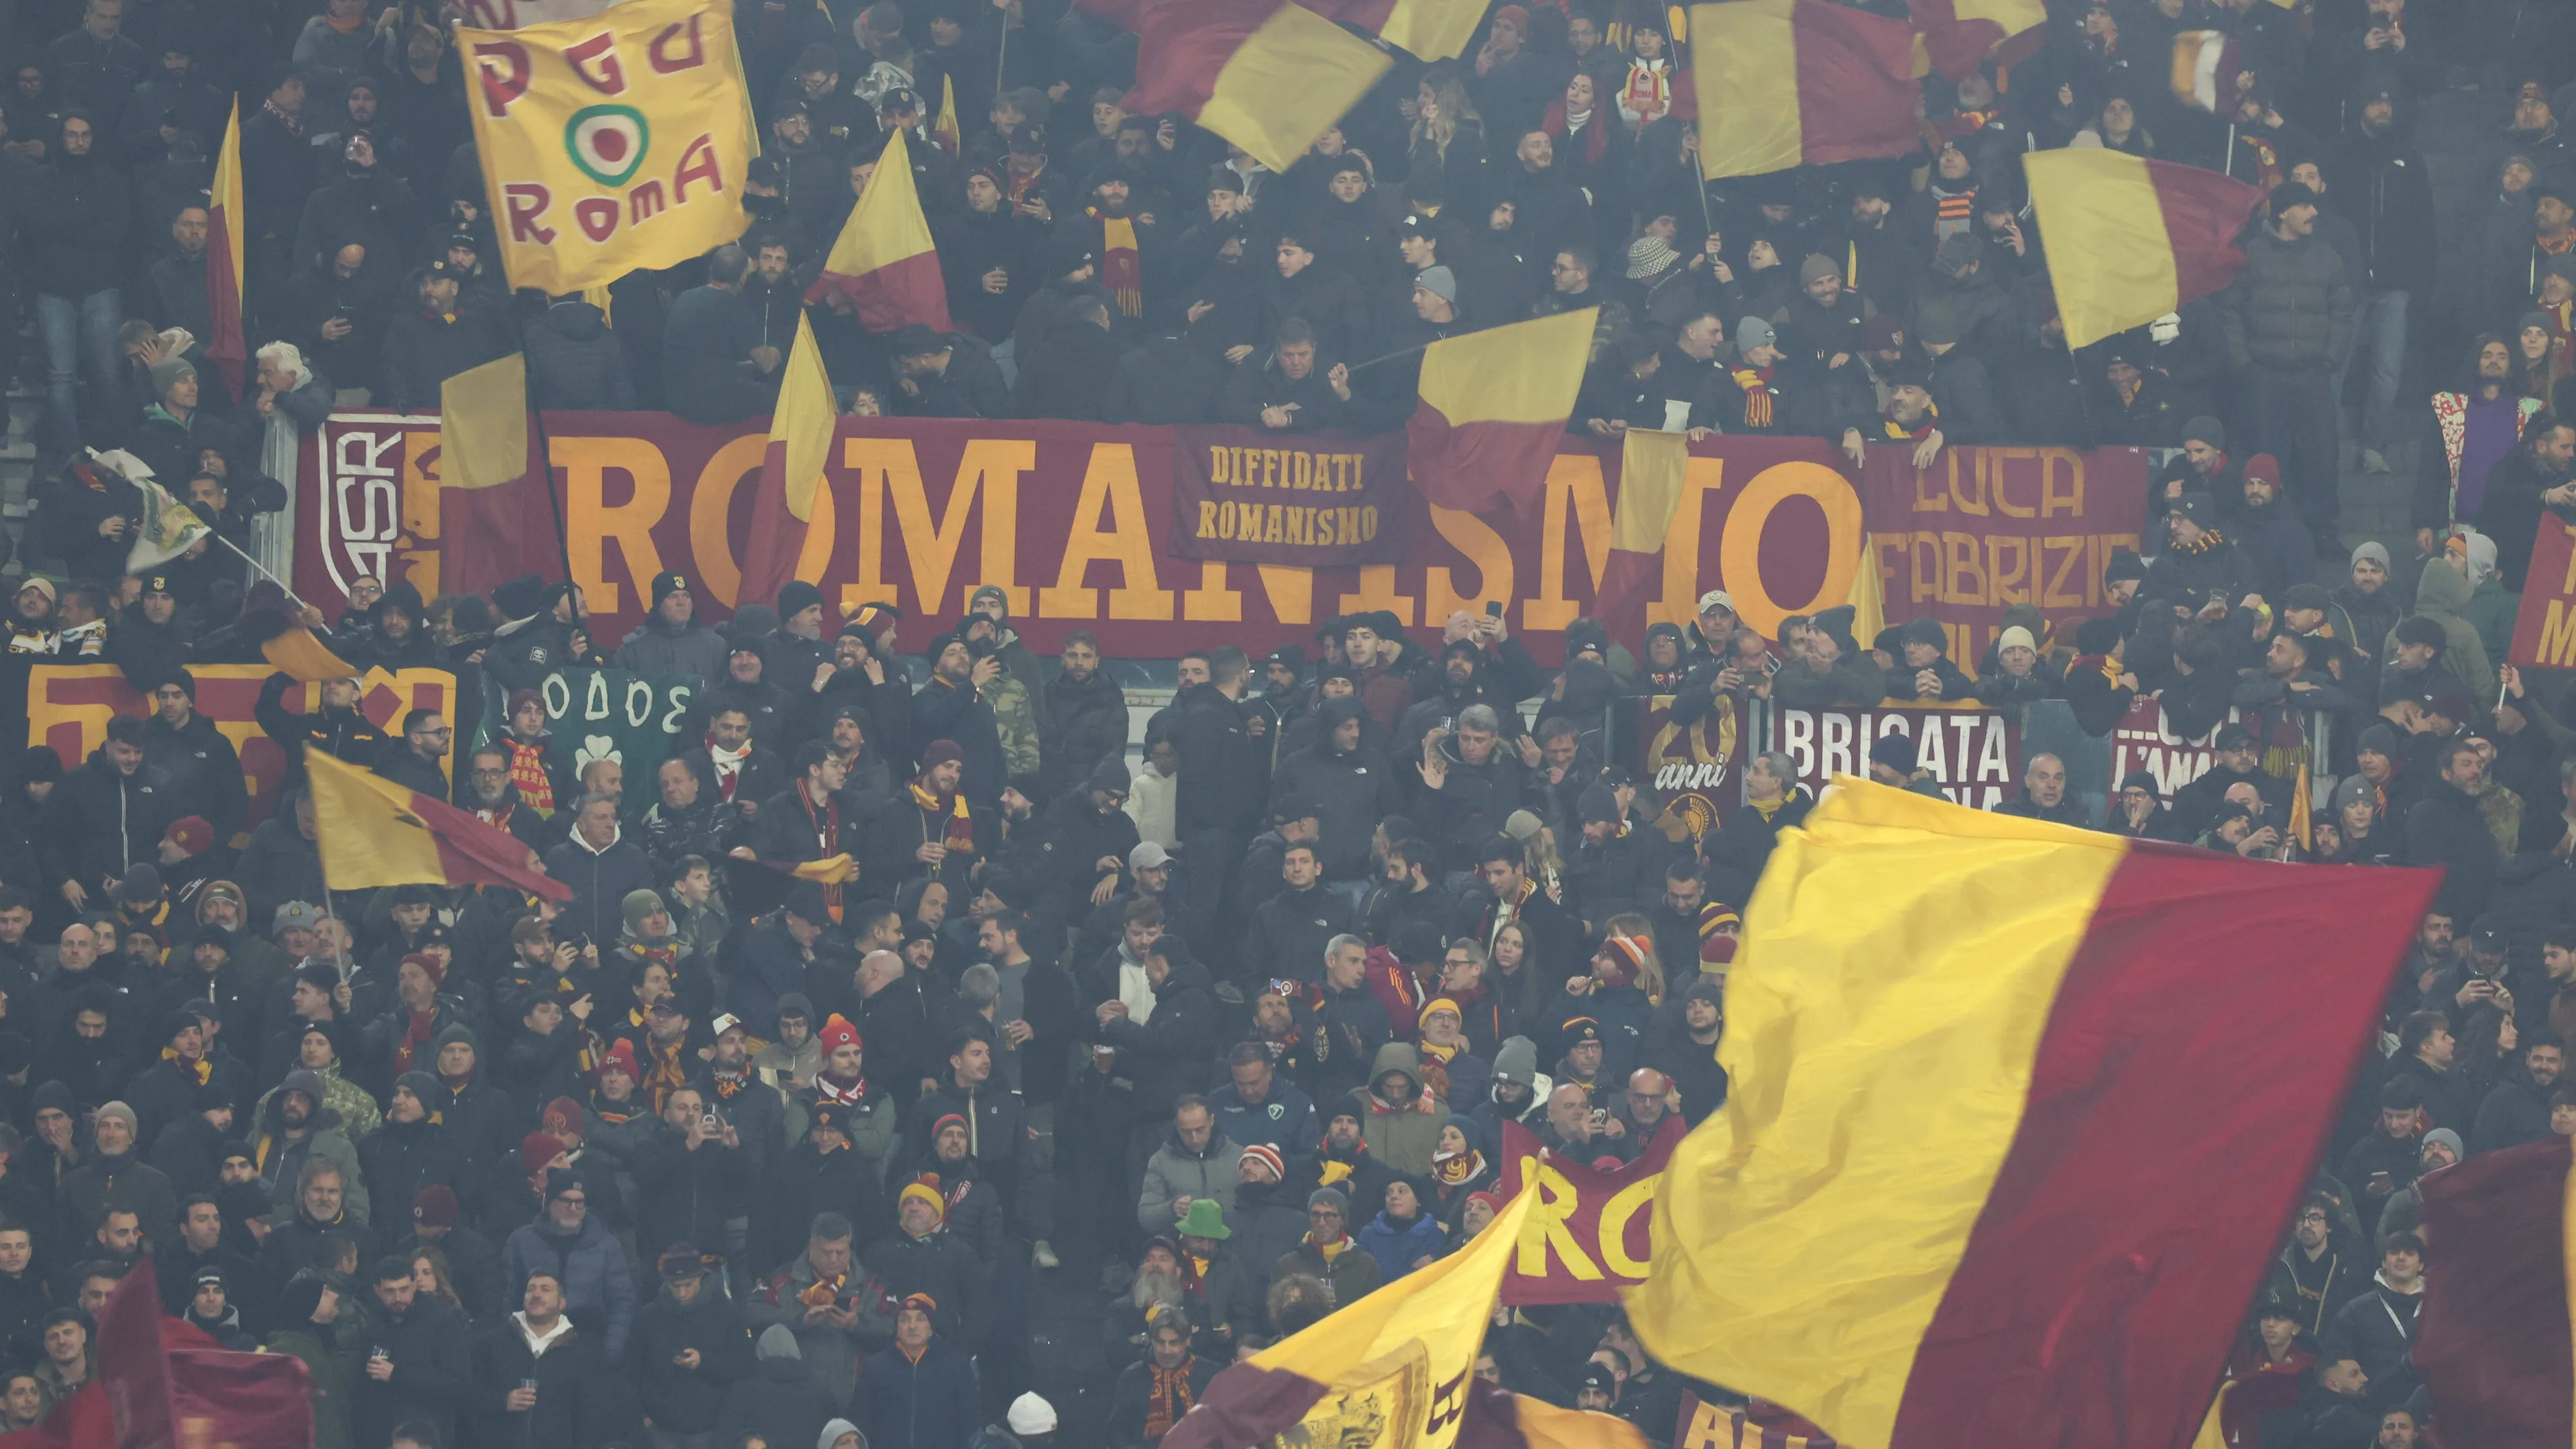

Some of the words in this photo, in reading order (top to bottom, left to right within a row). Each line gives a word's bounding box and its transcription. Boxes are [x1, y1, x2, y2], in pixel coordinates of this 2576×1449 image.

[1210, 445, 1364, 492] DIFFIDATI
[549, 435, 1864, 641] ROMASMO
[1196, 500, 1379, 547] ROMANISMO
[1654, 753, 1726, 790] anni
